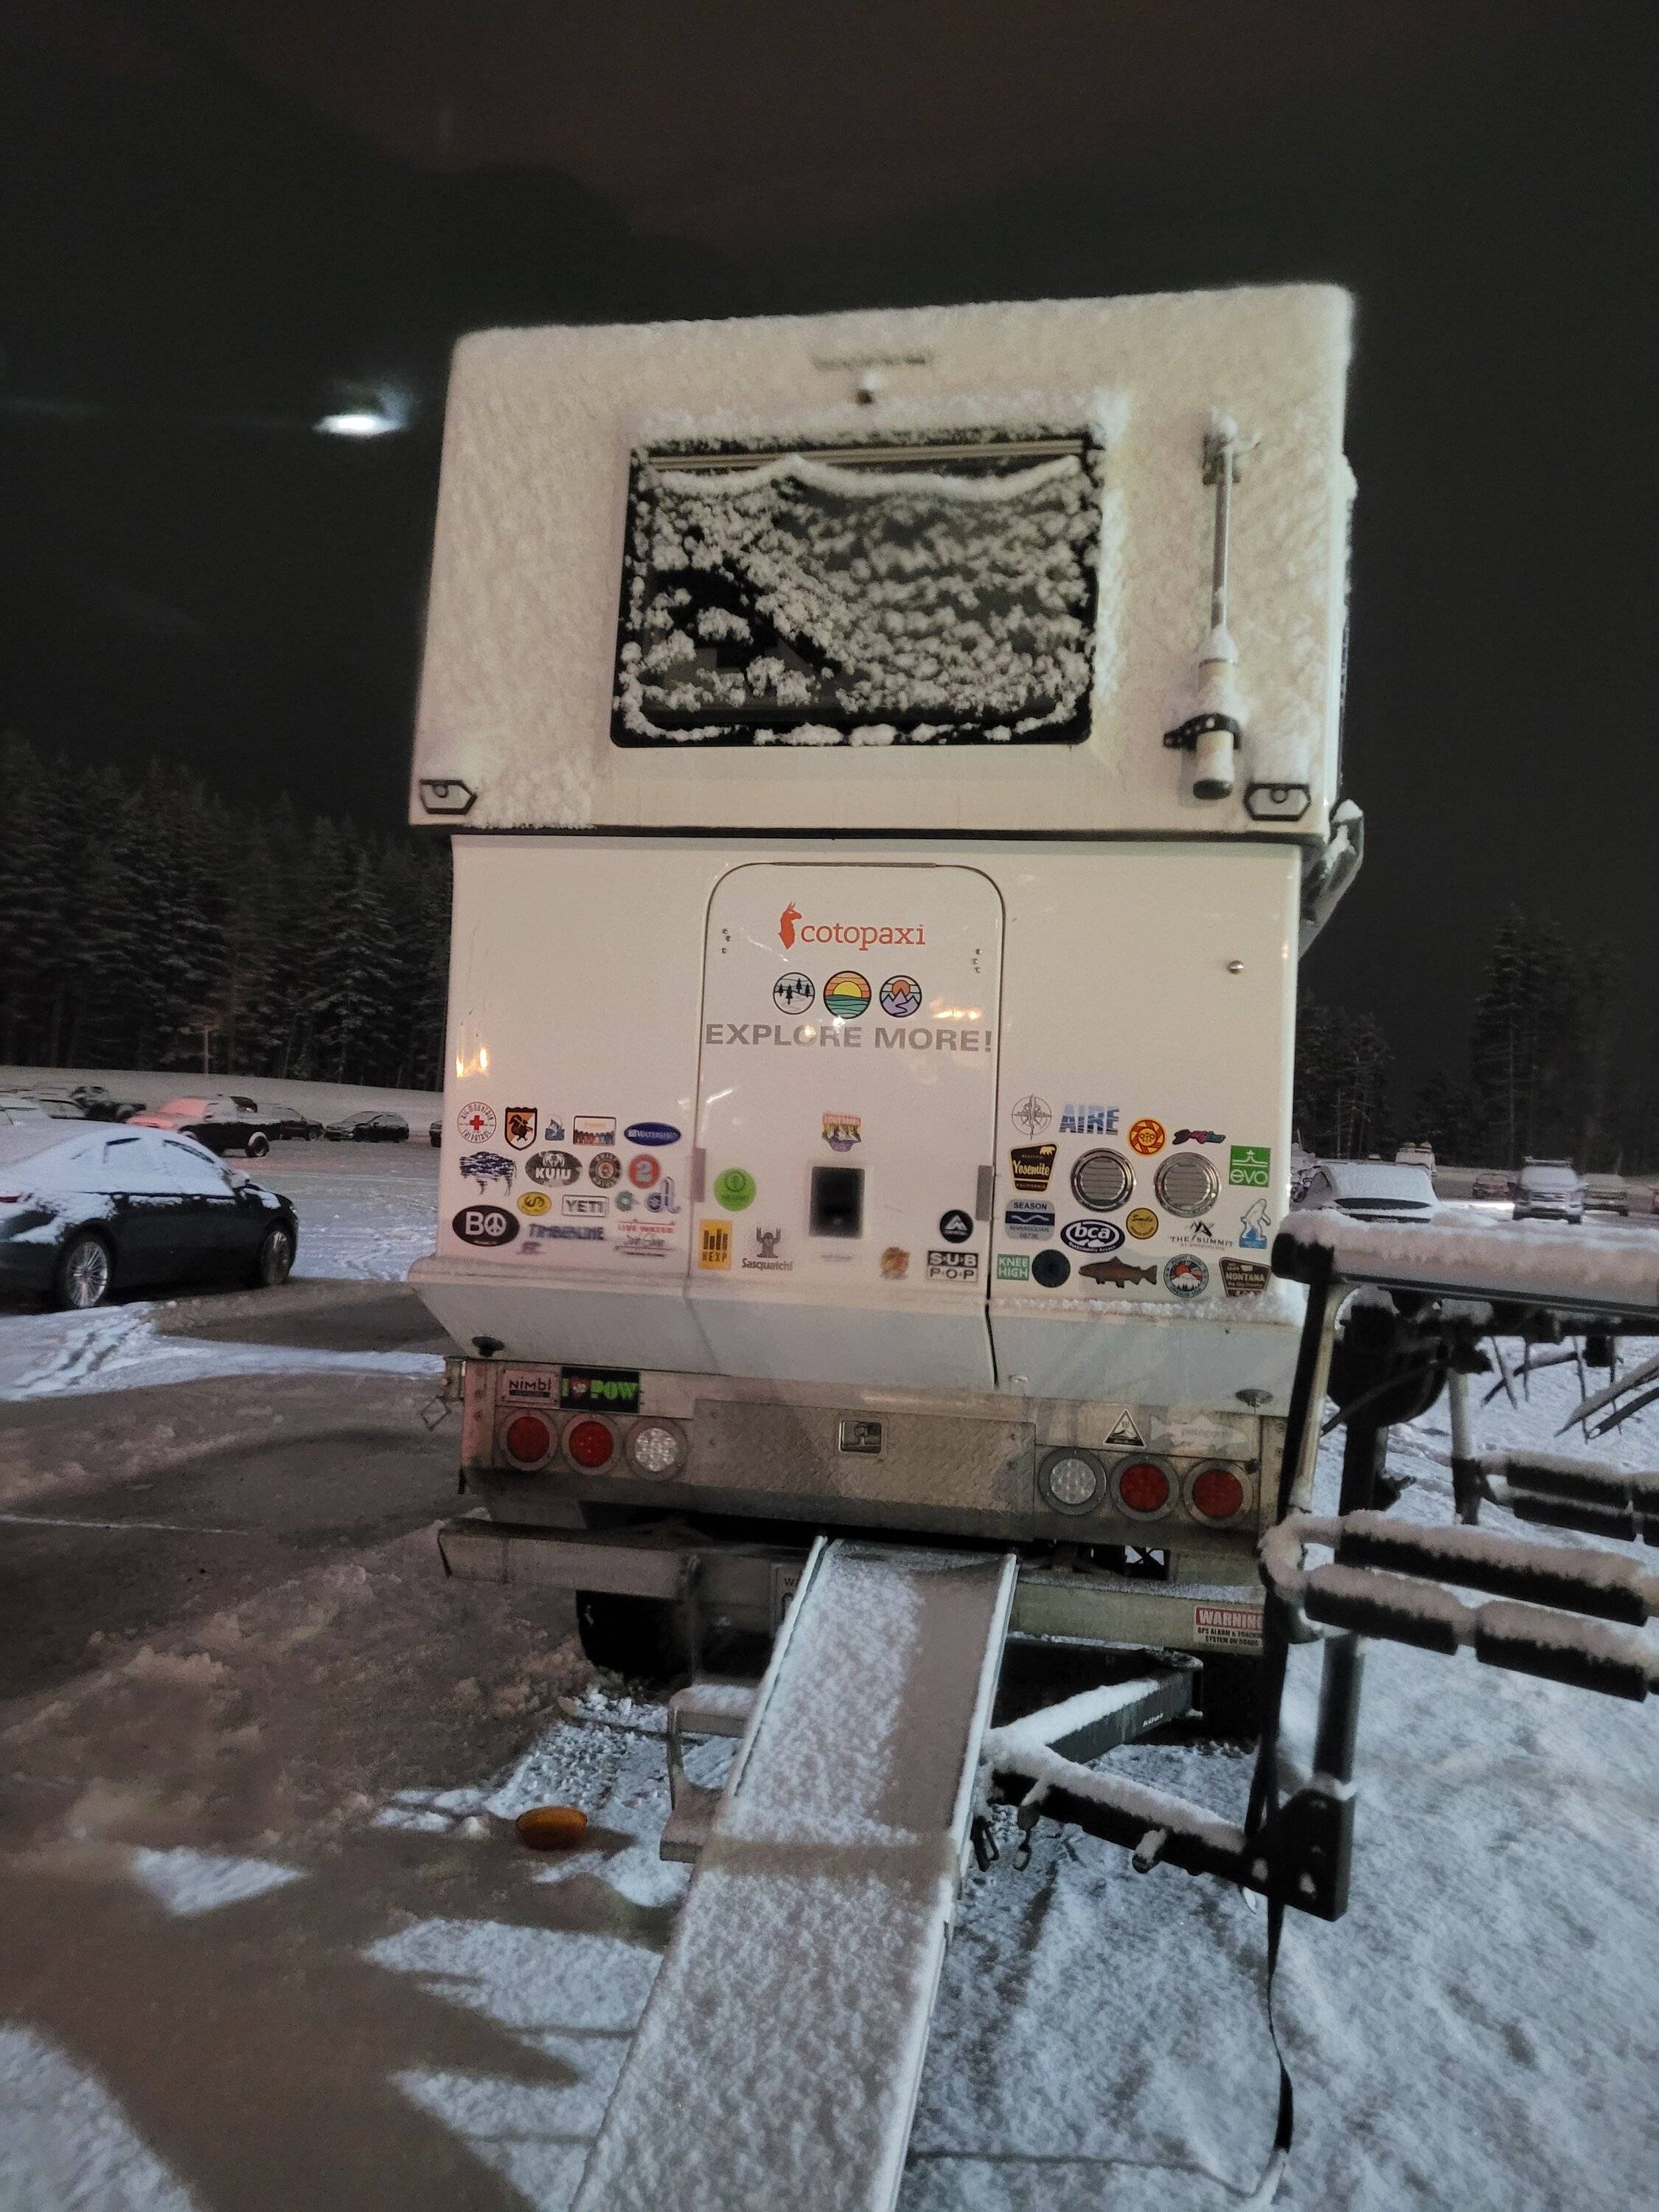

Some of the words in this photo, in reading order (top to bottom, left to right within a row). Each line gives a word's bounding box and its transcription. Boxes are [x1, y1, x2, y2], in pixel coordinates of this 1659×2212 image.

[801, 923, 925, 951] cotopaxi
[705, 1023, 862, 1049] EXPLORE
[874, 1027, 992, 1052] MORE!
[1012, 1160, 1050, 1176] Yosemite
[1231, 1169, 1267, 1185] evo
[566, 1200, 604, 1214] YETI
[1013, 1202, 1048, 1210] SEASON
[1074, 1222, 1111, 1239] bca
[1196, 1237, 1234, 1248] SUMMIT
[929, 1252, 977, 1266] SUB
[999, 1256, 1029, 1267] KNEE
[929, 1268, 974, 1280] POP
[998, 1267, 1029, 1279] HIGH
[1225, 1272, 1265, 1283] MONTANA
[1210, 1628, 1231, 1636] ALARM
